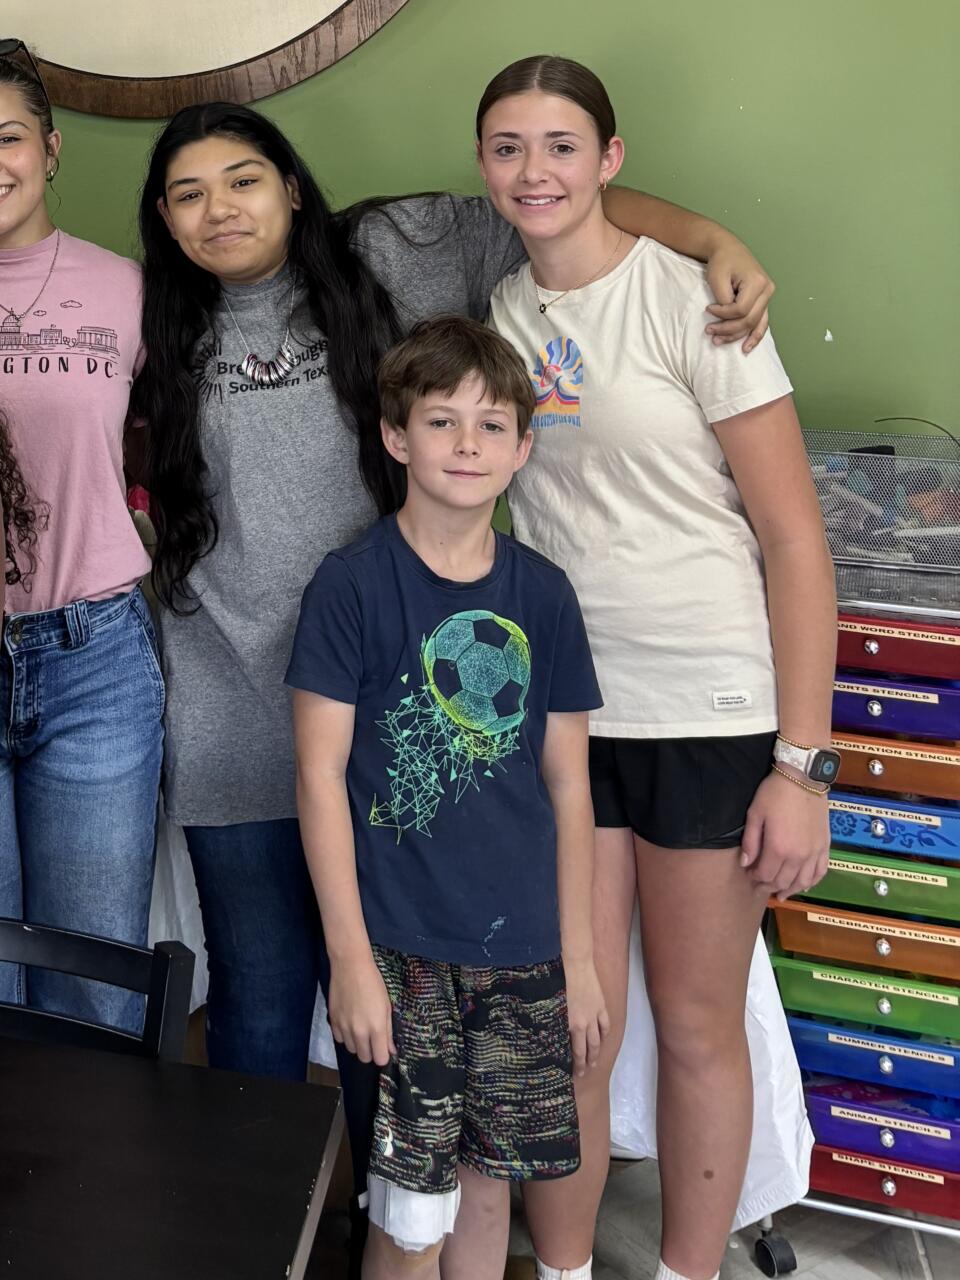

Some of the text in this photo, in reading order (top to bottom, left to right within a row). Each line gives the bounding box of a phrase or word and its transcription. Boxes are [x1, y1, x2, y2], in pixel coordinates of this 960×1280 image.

[303, 365, 328, 383] Tex
[860, 625, 895, 635] WORD
[898, 630, 957, 642] STENCILS
[833, 683, 930, 700] ORTS STENCILS
[829, 803, 933, 822] LOWER STENCILS
[829, 861, 939, 883] HOLIDAY STENCILS
[818, 916, 956, 943] CELEBRATION STENCILS
[820, 973, 950, 1001] CHARACTER STENCILS
[836, 1036, 945, 1061] SUMMER STENCILS
[839, 1110, 942, 1135] ANIMAL STENCILS
[837, 1154, 935, 1179] SHAPE STENCILS
